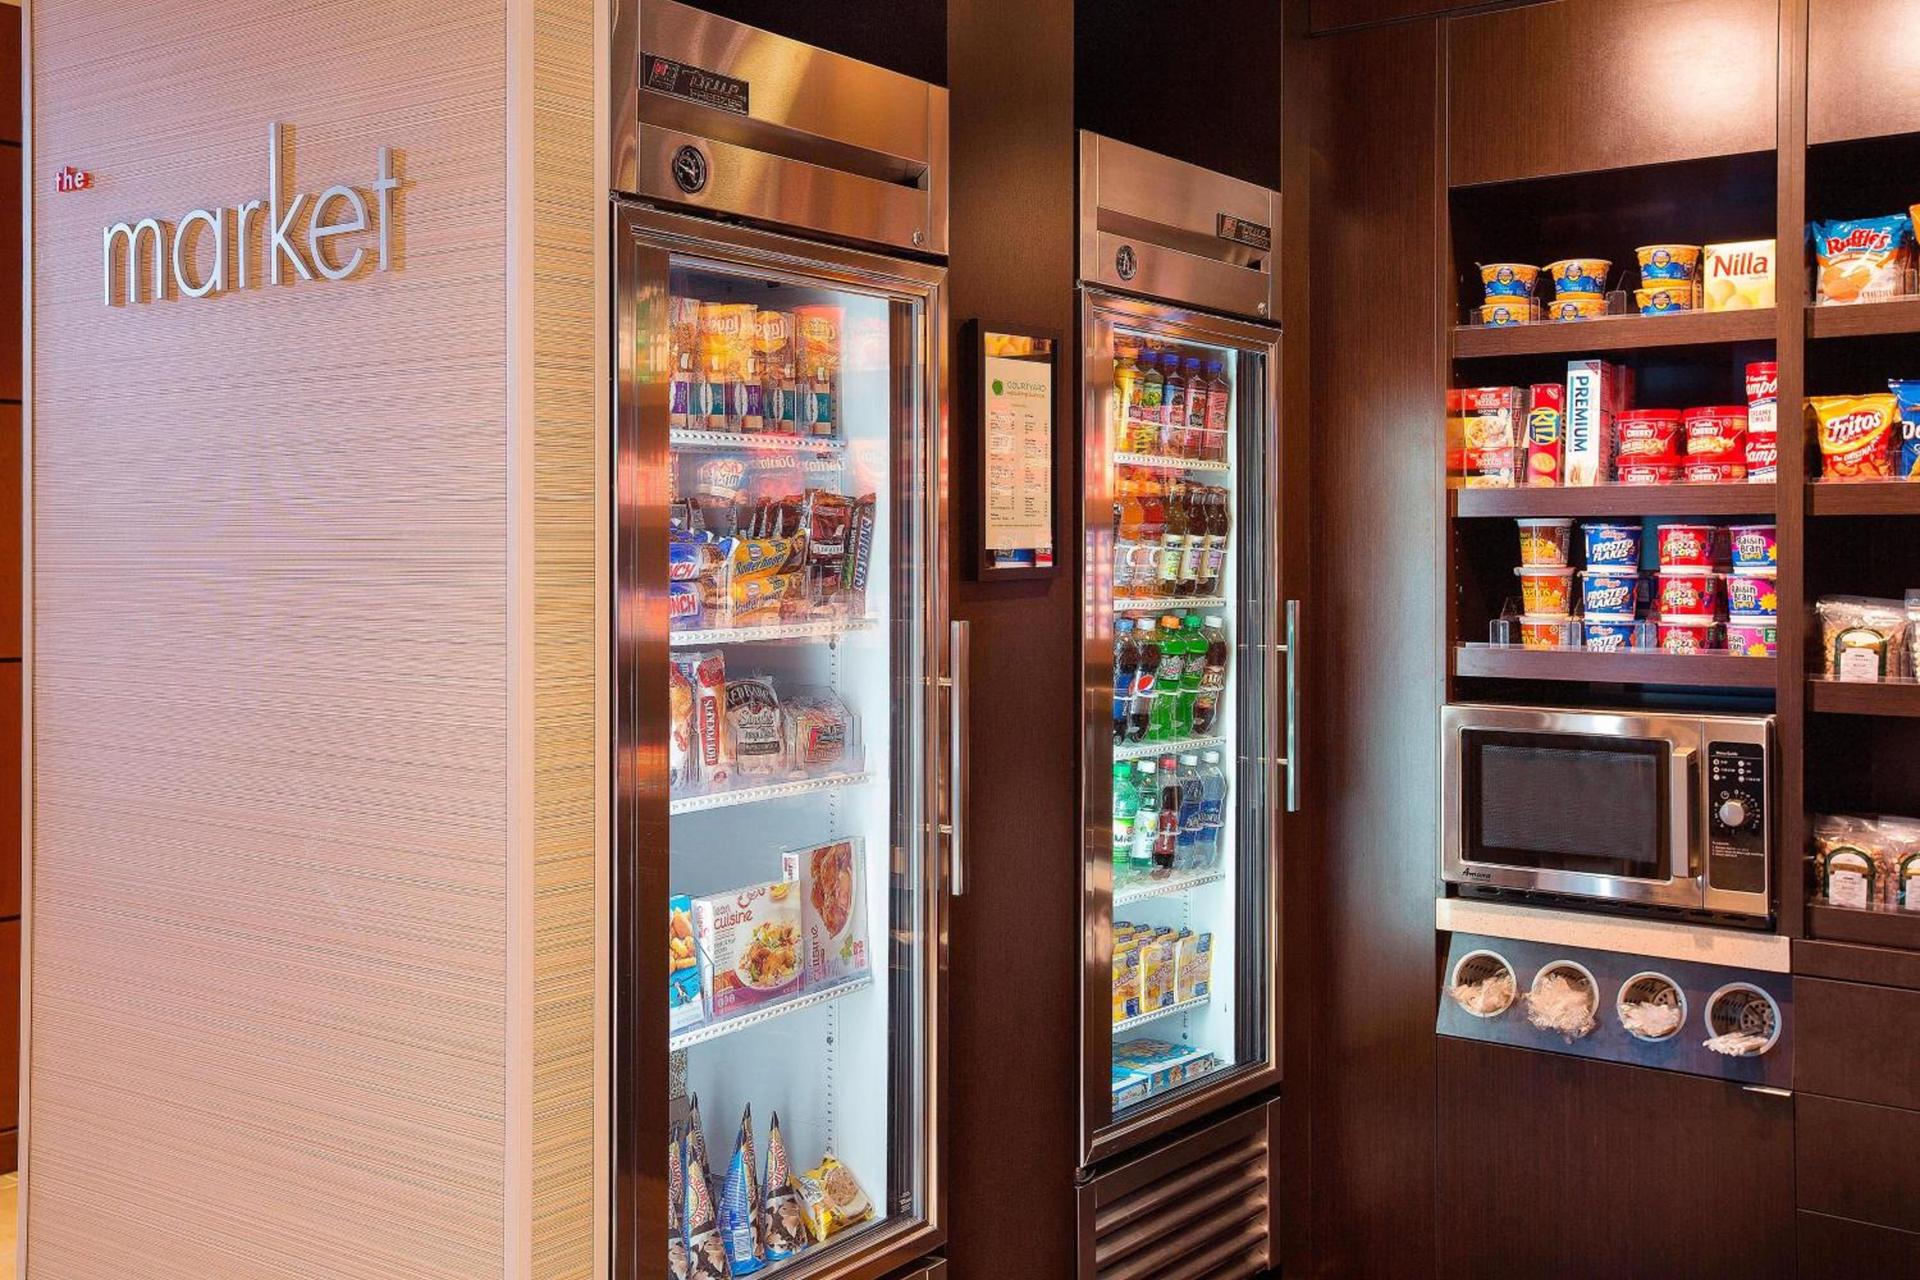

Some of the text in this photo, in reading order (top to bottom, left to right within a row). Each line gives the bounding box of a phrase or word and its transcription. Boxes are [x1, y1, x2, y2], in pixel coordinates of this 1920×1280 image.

[55, 166, 90, 192] the
[103, 122, 398, 306] market
[1826, 229, 1892, 256] Ruffles
[1713, 252, 1768, 277] Nilla
[1530, 410, 1557, 443] RITZ
[1574, 375, 1590, 452] PREMIUM
[1826, 411, 1881, 444] Fritos
[1592, 539, 1634, 554] FROSTED
[1593, 550, 1628, 562] FLAKES
[1587, 587, 1629, 602] FROSTED
[1588, 597, 1622, 610] FLAKES
[703, 699, 717, 741] POCKETS
[714, 910, 753, 930] cuisine
